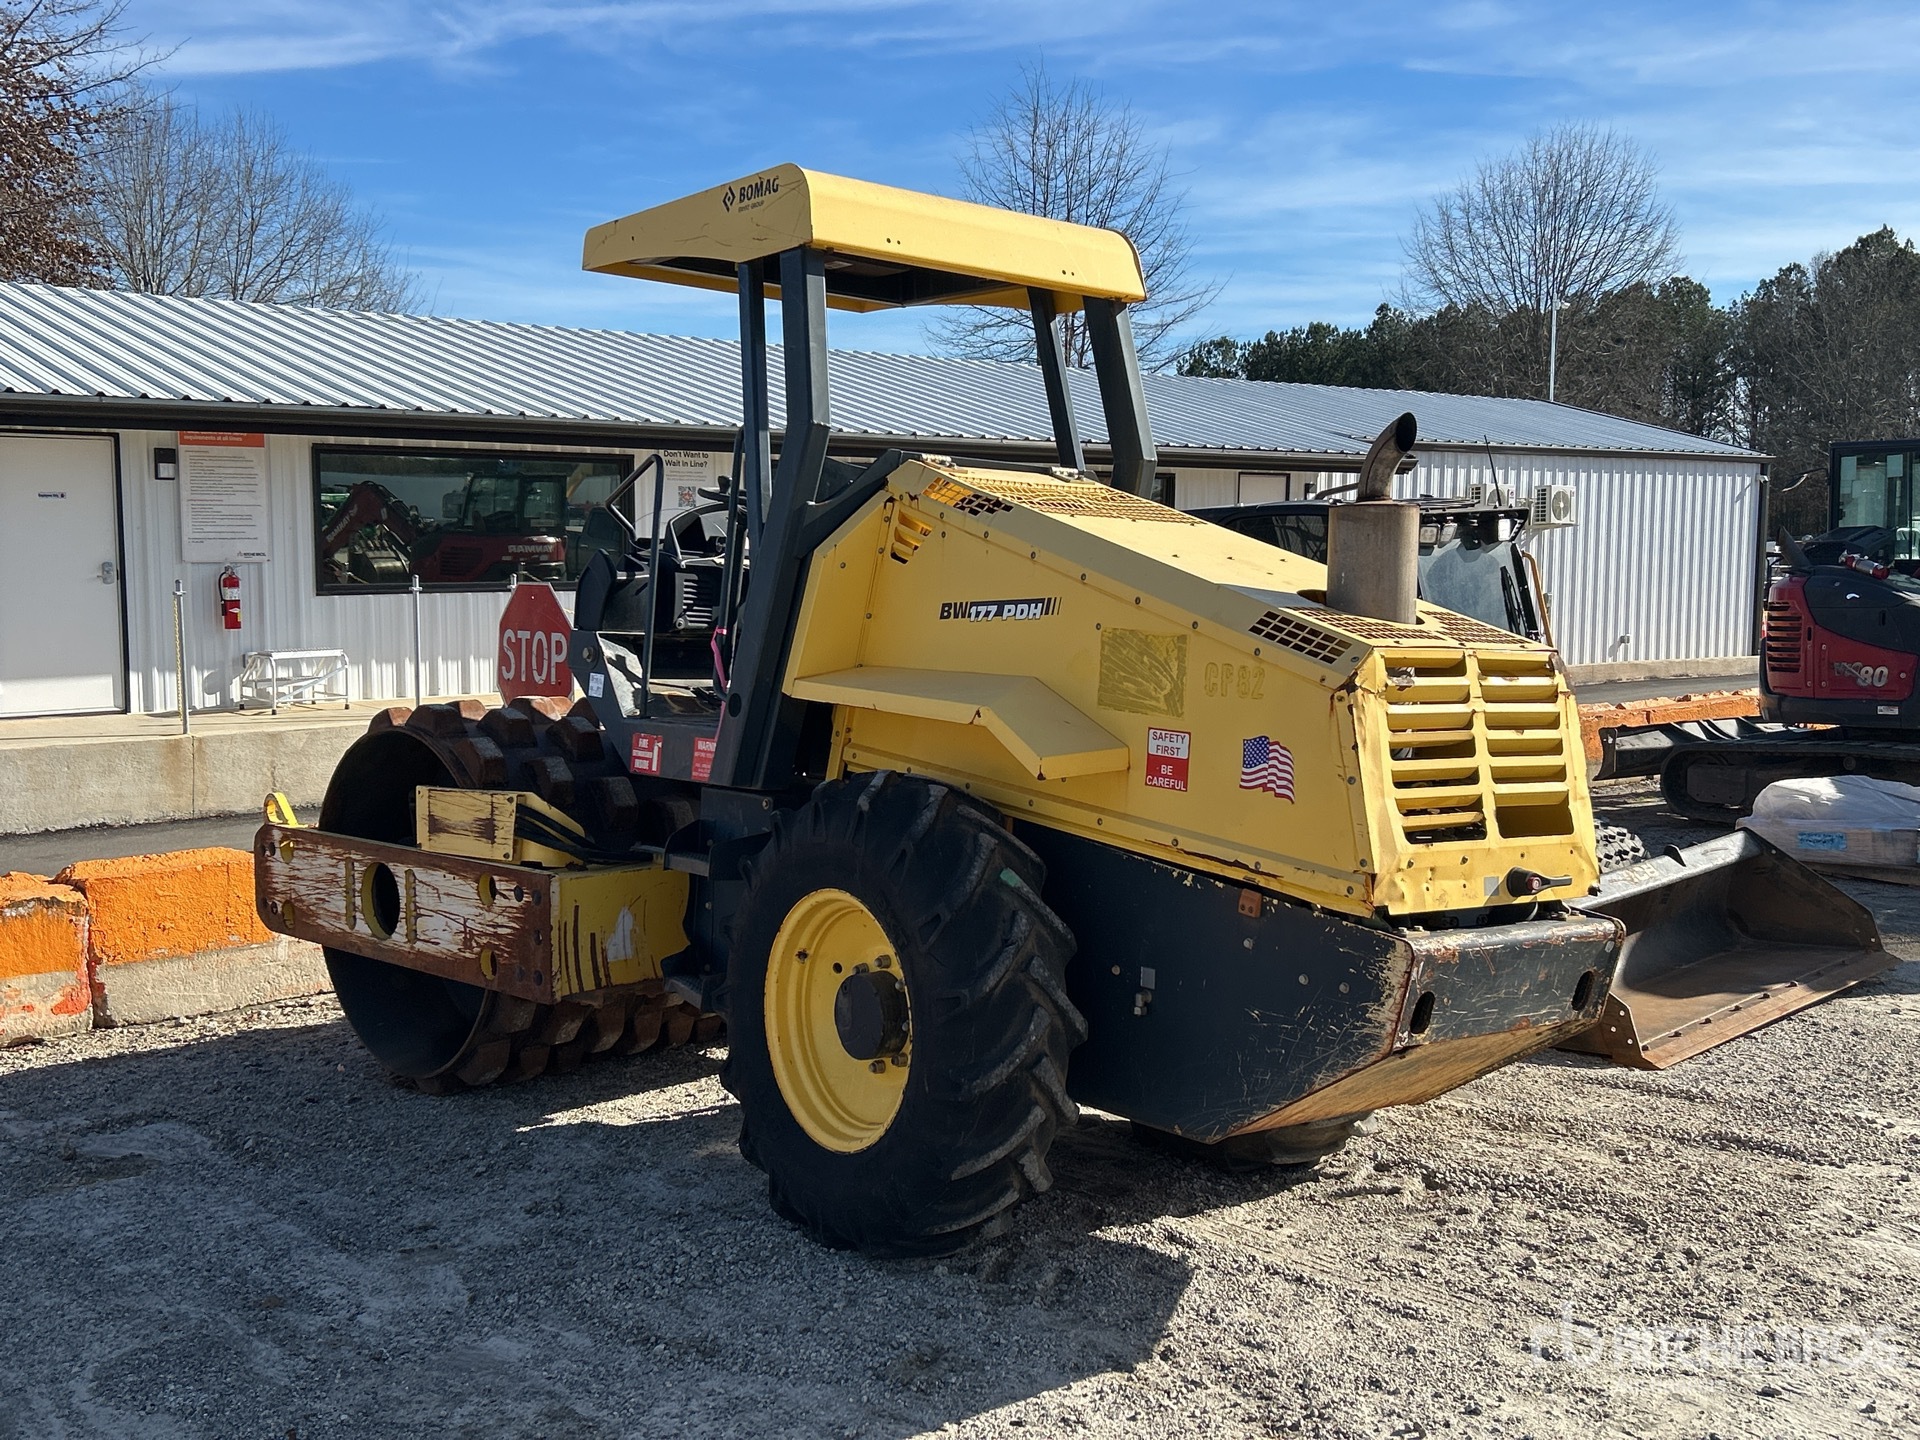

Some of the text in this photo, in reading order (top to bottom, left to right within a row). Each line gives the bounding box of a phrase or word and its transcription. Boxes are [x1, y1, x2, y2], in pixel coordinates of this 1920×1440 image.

[738, 176, 779, 204] BOMAG
[663, 450, 682, 458] Don't
[684, 451, 700, 459] Want
[690, 460, 708, 468] Line?
[1001, 602, 1043, 621] PDH
[502, 628, 568, 685] STOP
[1152, 730, 1187, 745] SAFETY
[1155, 744, 1181, 757] FIRST
[1160, 764, 1173, 776] BE
[1146, 775, 1187, 791] CAREFUL
